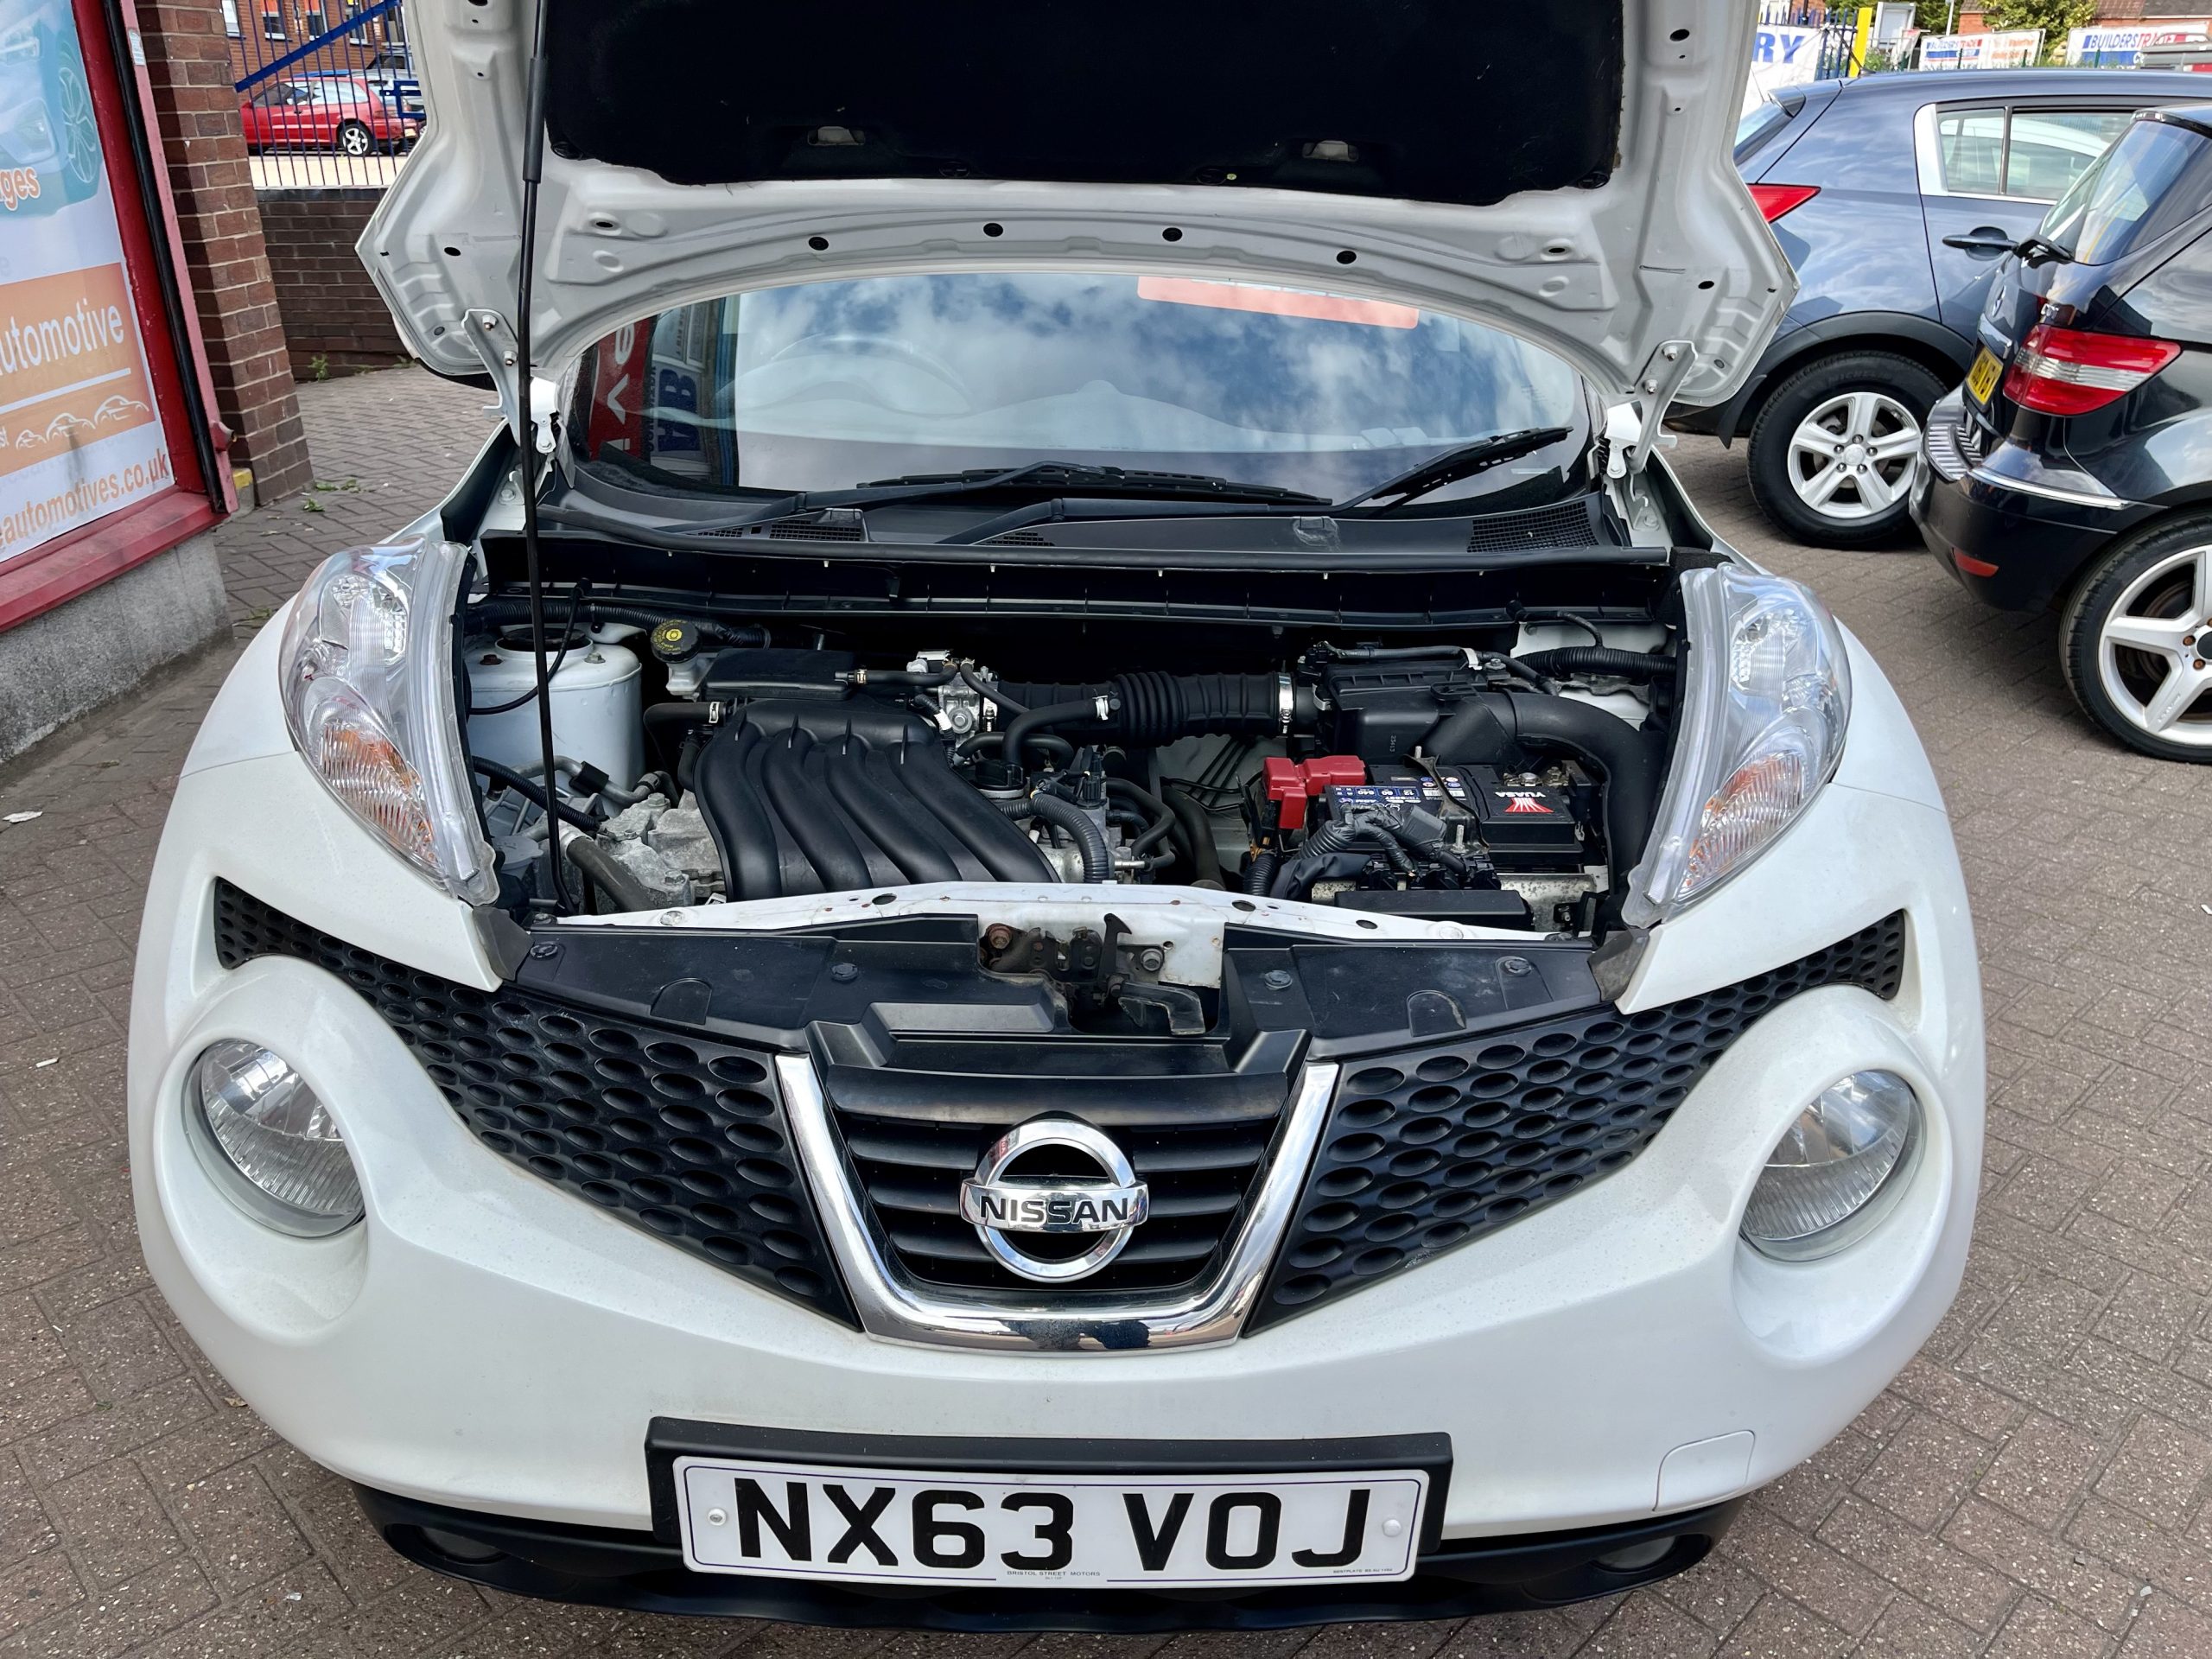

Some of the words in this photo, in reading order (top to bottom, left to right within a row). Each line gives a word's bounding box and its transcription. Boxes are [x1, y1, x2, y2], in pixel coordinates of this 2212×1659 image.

[0, 167, 41, 211] ges
[0, 298, 124, 375] utomotive
[980, 1195, 1128, 1225] NISSAN
[734, 1478, 1074, 1571] NX63
[1122, 1489, 1371, 1571] VOJ
